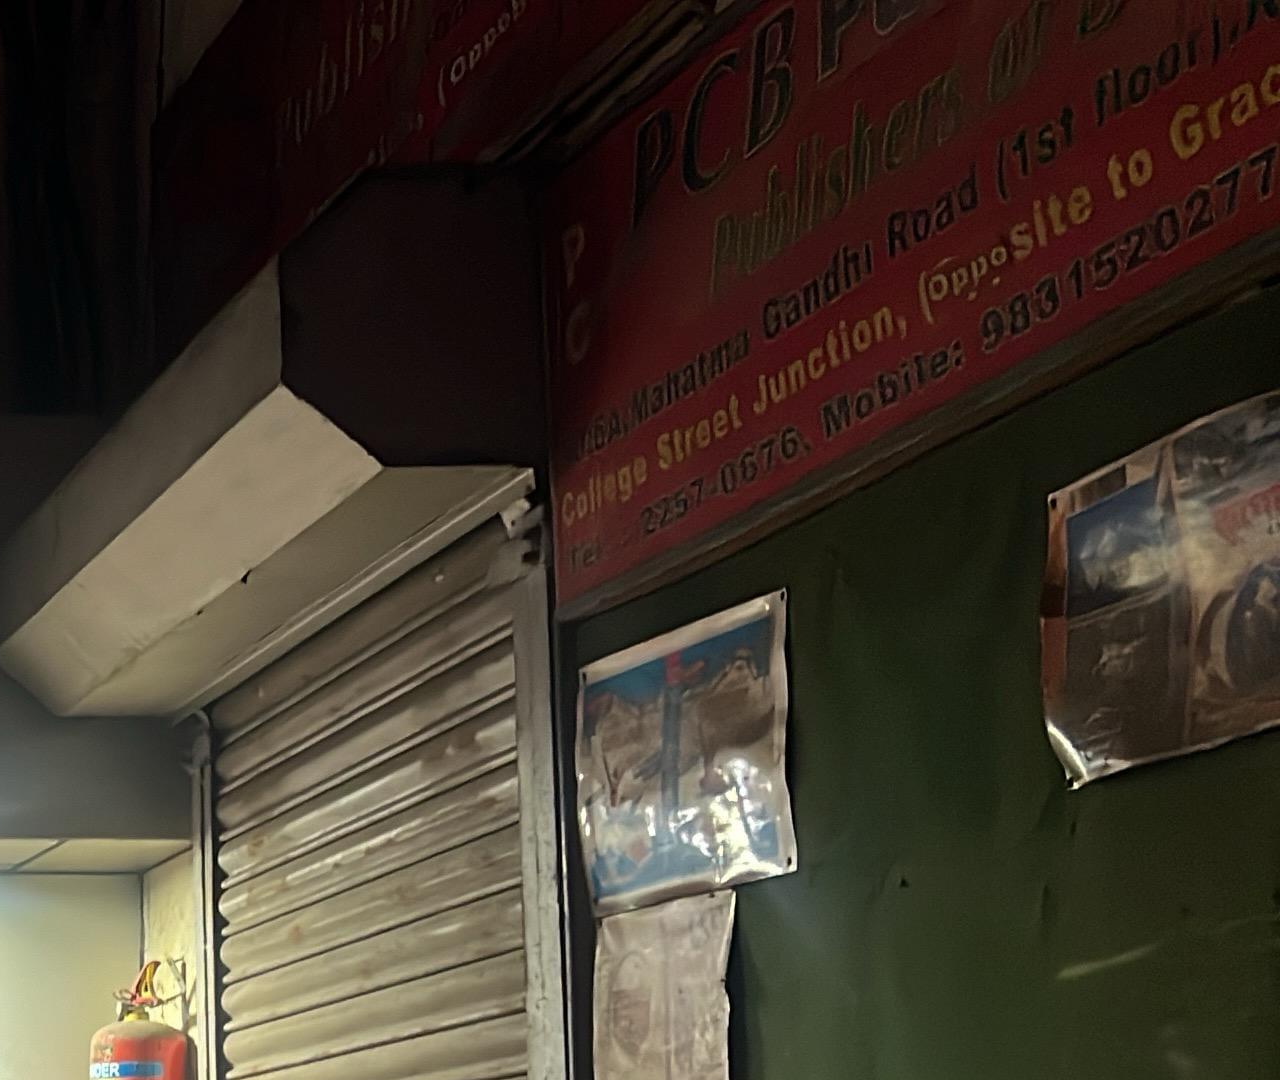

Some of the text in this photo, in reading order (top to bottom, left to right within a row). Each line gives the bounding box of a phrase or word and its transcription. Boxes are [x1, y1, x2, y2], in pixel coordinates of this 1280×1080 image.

[630, 5, 798, 235] PCB
[886, 160, 980, 258] Road
[655, 393, 744, 472] Street
[751, 303, 908, 415] Junction,
[1106, 146, 1154, 200] to
[819, 338, 966, 442] Mobile:
[979, 143, 1280, 357] 9831520277
